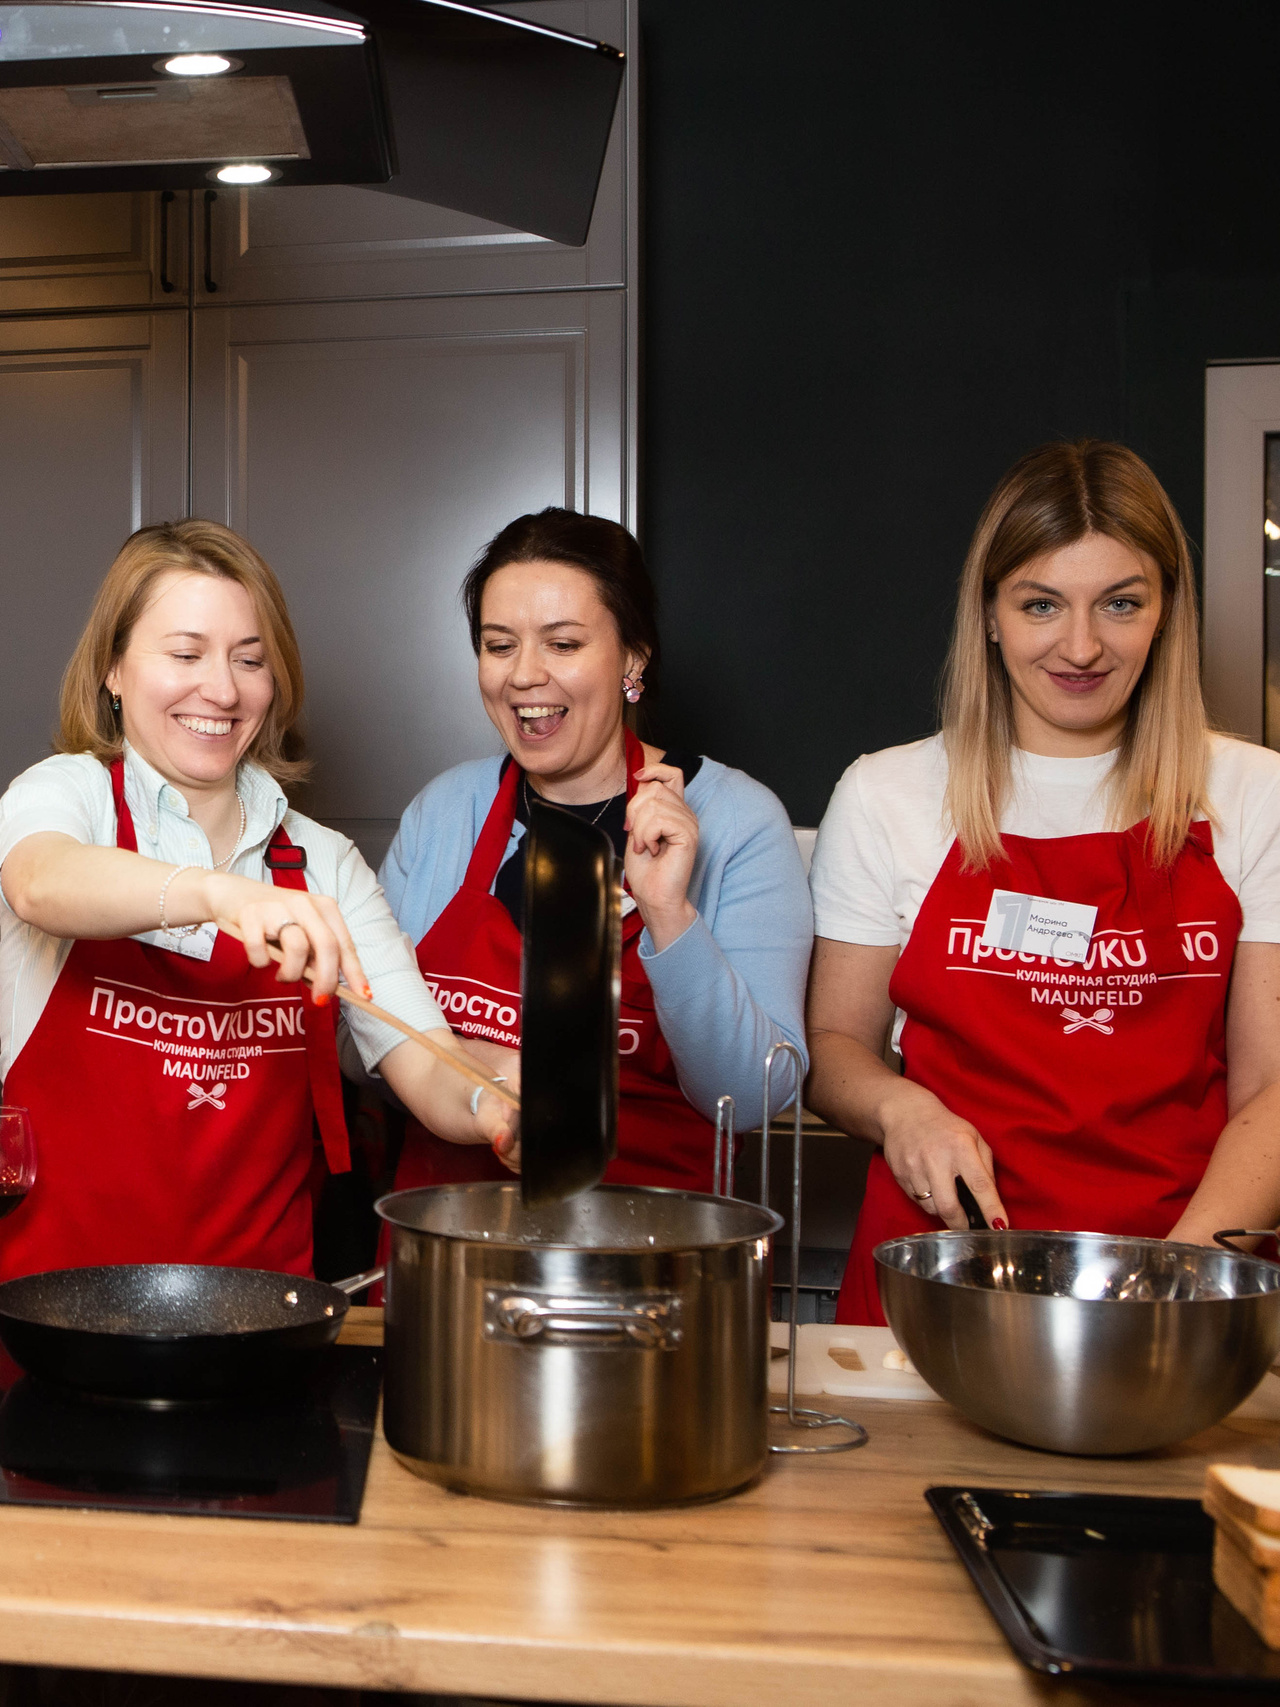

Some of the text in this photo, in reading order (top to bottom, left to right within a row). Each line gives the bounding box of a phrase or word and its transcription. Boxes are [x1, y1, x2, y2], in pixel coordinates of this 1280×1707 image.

[1029, 913, 1068, 928] Марина
[1026, 924, 1074, 939] Андреева
[1016, 969, 1158, 987] КУЛИНАРНАЯ СТУДИЯ
[1031, 987, 1143, 1007] MAUNFELD
[461, 1020, 523, 1047] КУЛИНАРН
[153, 1039, 263, 1060] КУЛИНАРНАЯ СТУДИЯ
[162, 1058, 250, 1081] MAUNFELD
